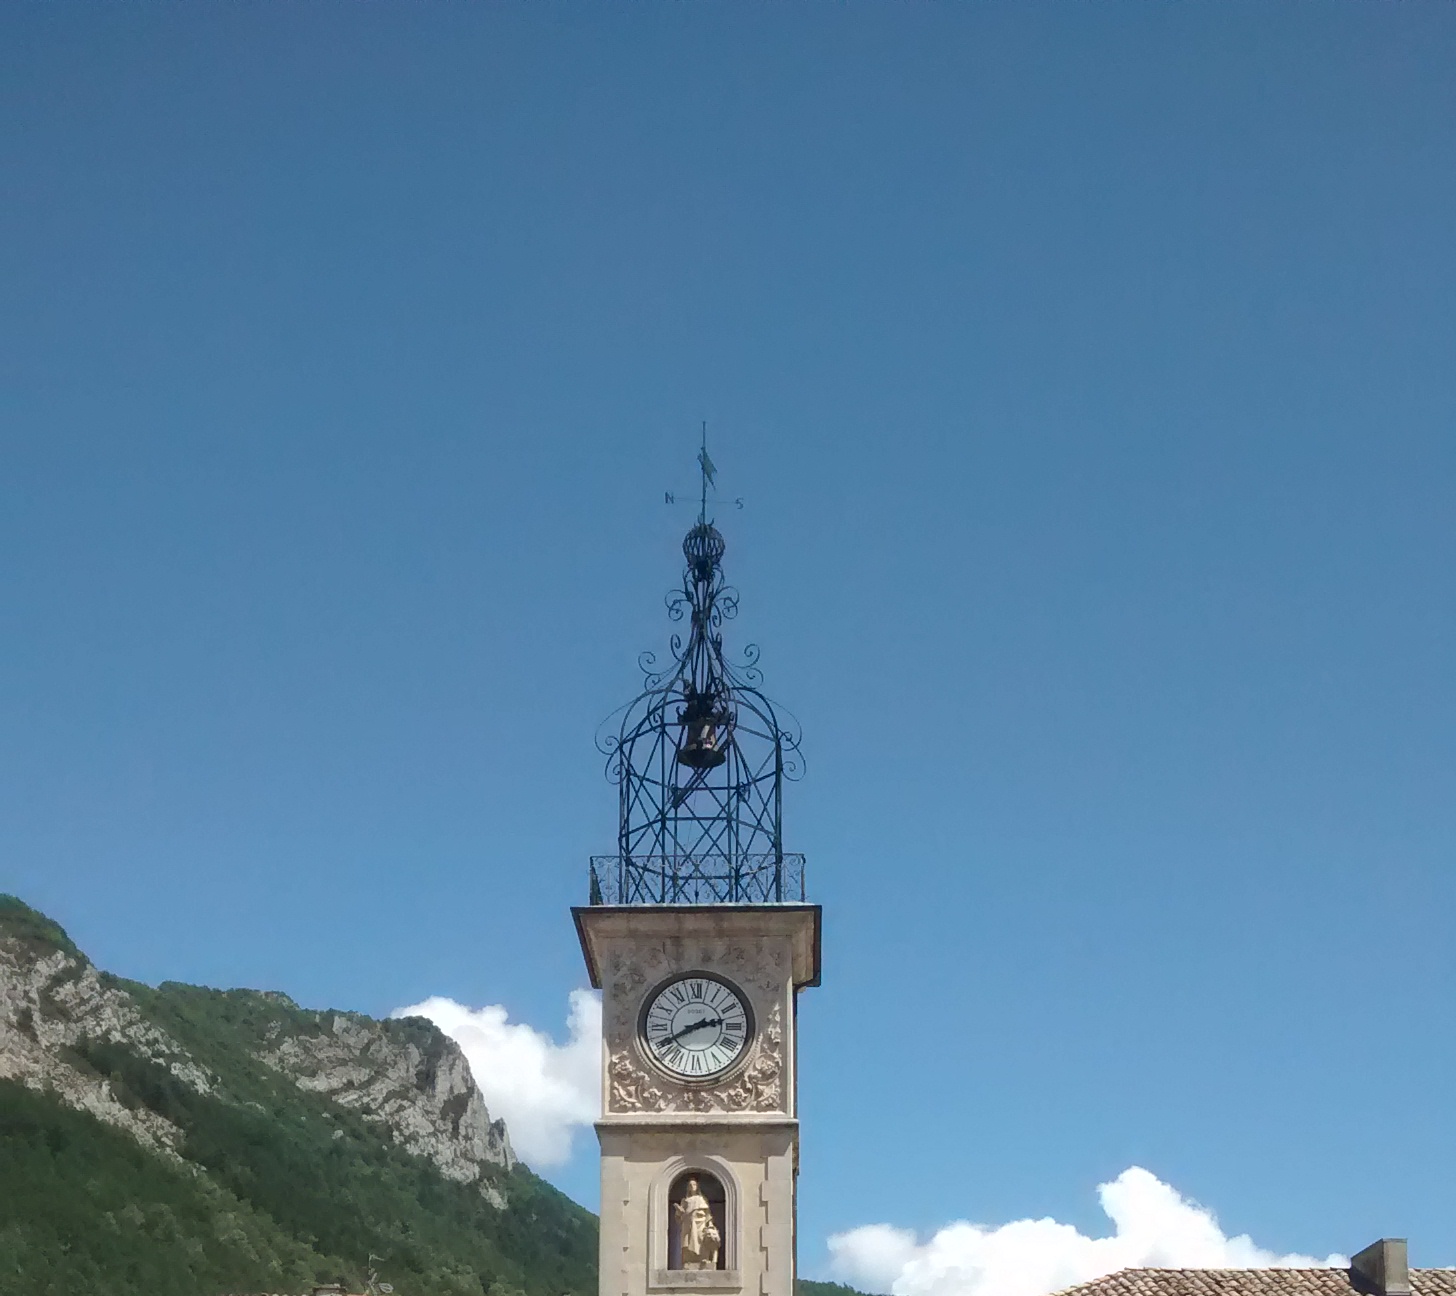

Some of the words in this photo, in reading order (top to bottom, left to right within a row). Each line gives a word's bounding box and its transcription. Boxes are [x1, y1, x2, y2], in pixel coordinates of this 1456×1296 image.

[664, 491, 675, 505] N
[735, 497, 744, 510] S
[689, 982, 703, 1000] XII
[725, 1022, 742, 1031] III
